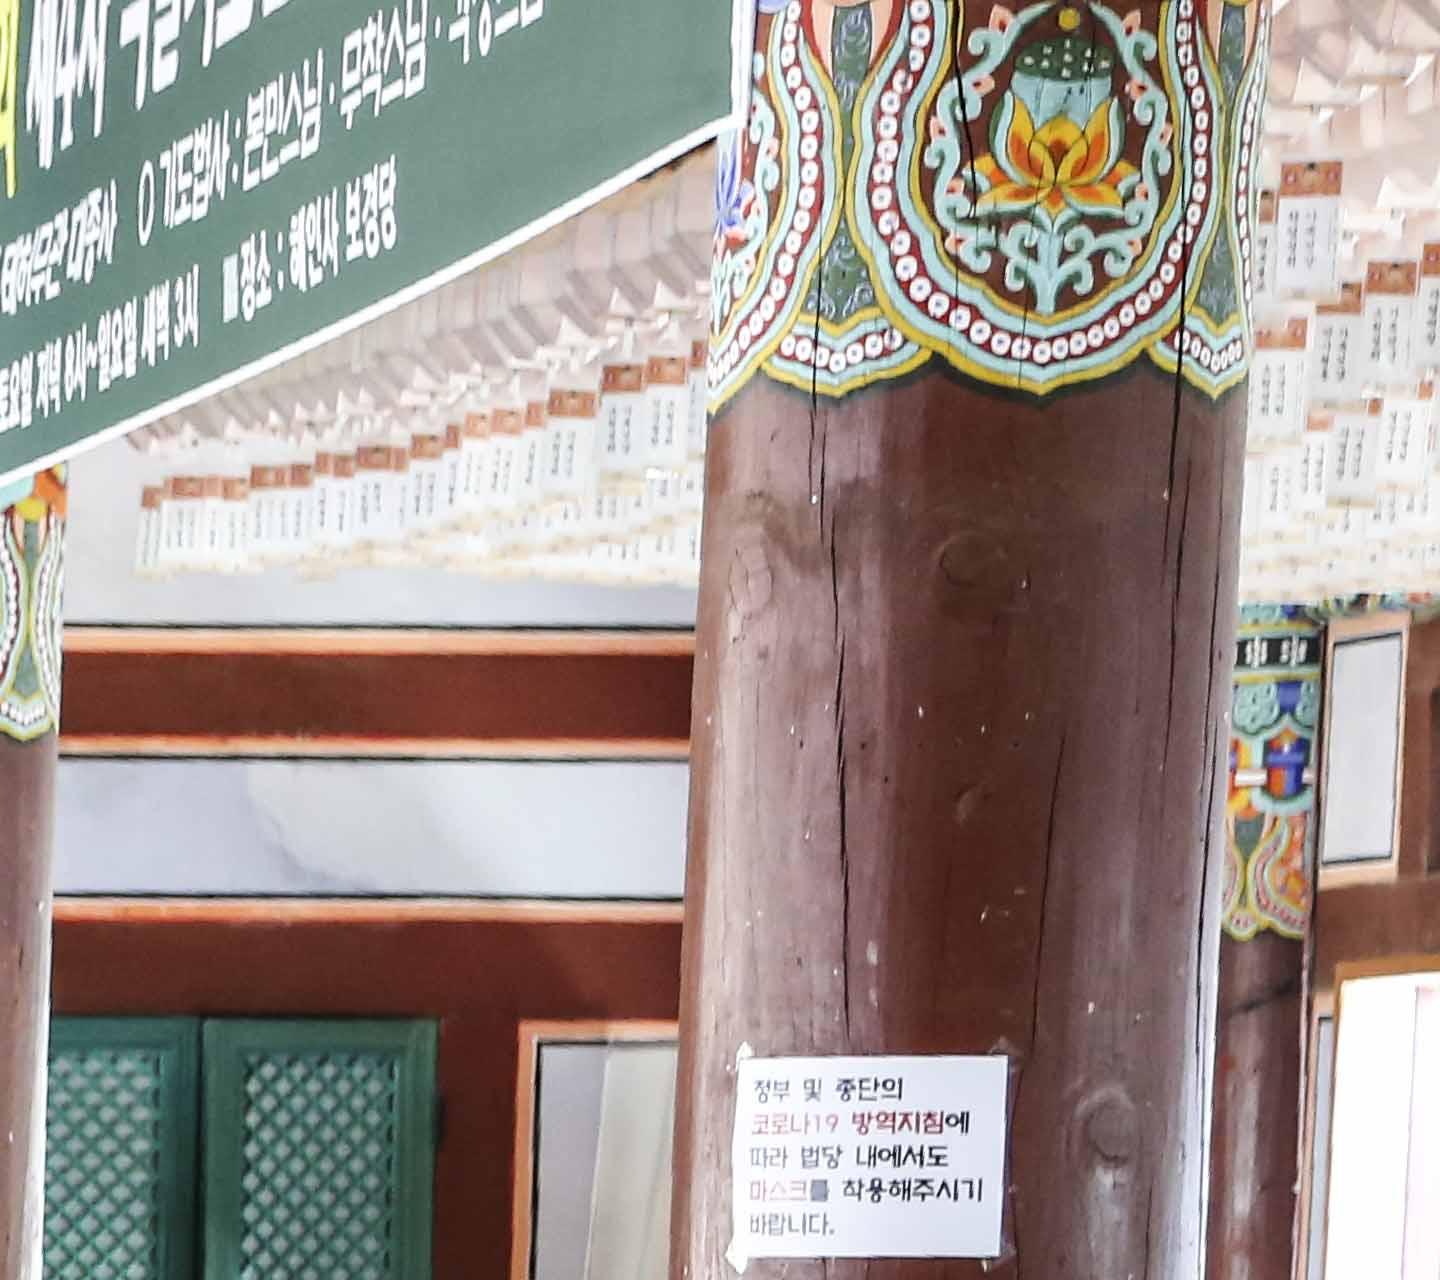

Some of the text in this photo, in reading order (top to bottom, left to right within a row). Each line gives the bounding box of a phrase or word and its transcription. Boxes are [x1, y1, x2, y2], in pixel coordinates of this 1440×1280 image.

[159, 109, 230, 229] 기도법사
[36, 337, 61, 418] 저녁
[141, 279, 170, 367] 새벽
[174, 264, 199, 348] 3시
[240, 229, 272, 322] 장소
[289, 185, 340, 293] 해인사
[346, 153, 397, 263] 보경당
[753, 1076, 904, 1104] 정부 및 종단의
[751, 1111, 971, 1136] 코로나19 방역지침에
[749, 1145, 950, 1169] 따라 법당 내에서도
[749, 1177, 984, 1203] 마스크를 착용해주시기
[749, 1212, 836, 1237] 바랍니다.
